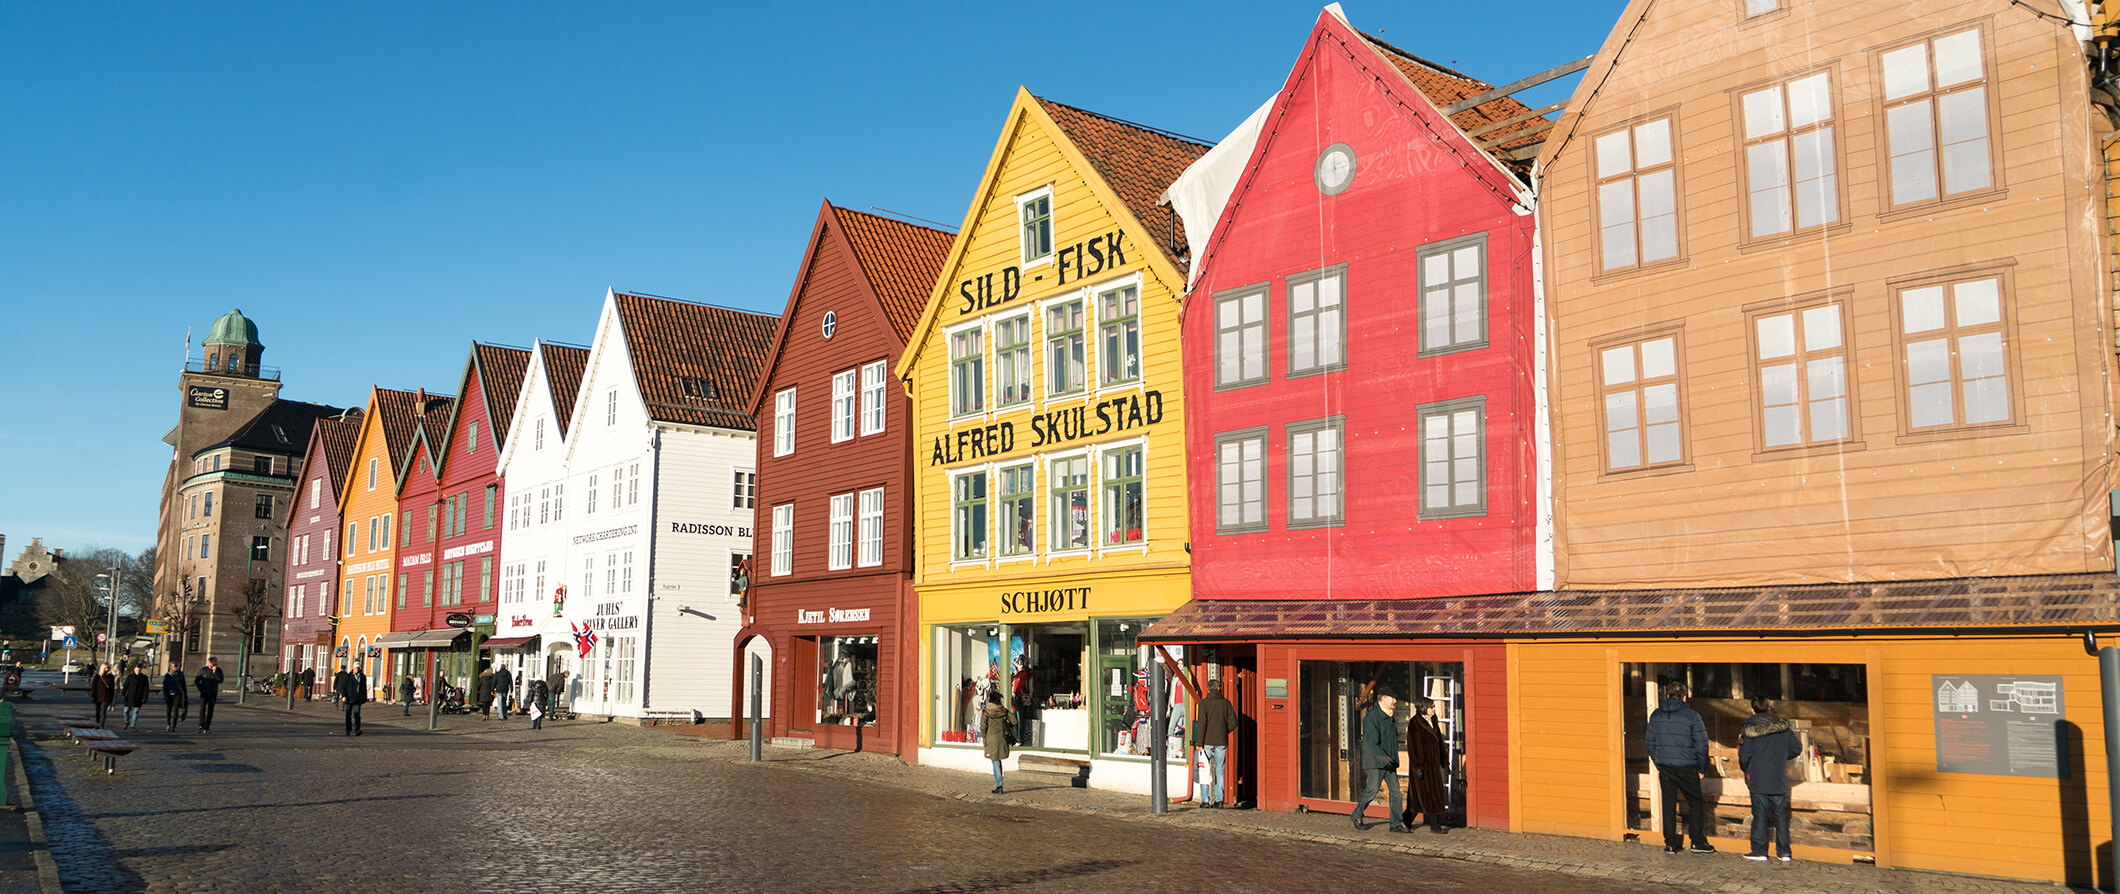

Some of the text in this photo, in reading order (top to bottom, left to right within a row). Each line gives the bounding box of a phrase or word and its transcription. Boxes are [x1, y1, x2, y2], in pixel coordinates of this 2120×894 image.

[960, 265, 1021, 315] SILD
[1057, 228, 1127, 286] FISK
[931, 389, 1164, 467] ALFRED SKULSTAD
[672, 522, 755, 538] RADISSON BL
[1001, 587, 1091, 614] SCHJØTT
[608, 615, 640, 630] GALLERY
[798, 607, 871, 624] KJETIL SØRENSEN
